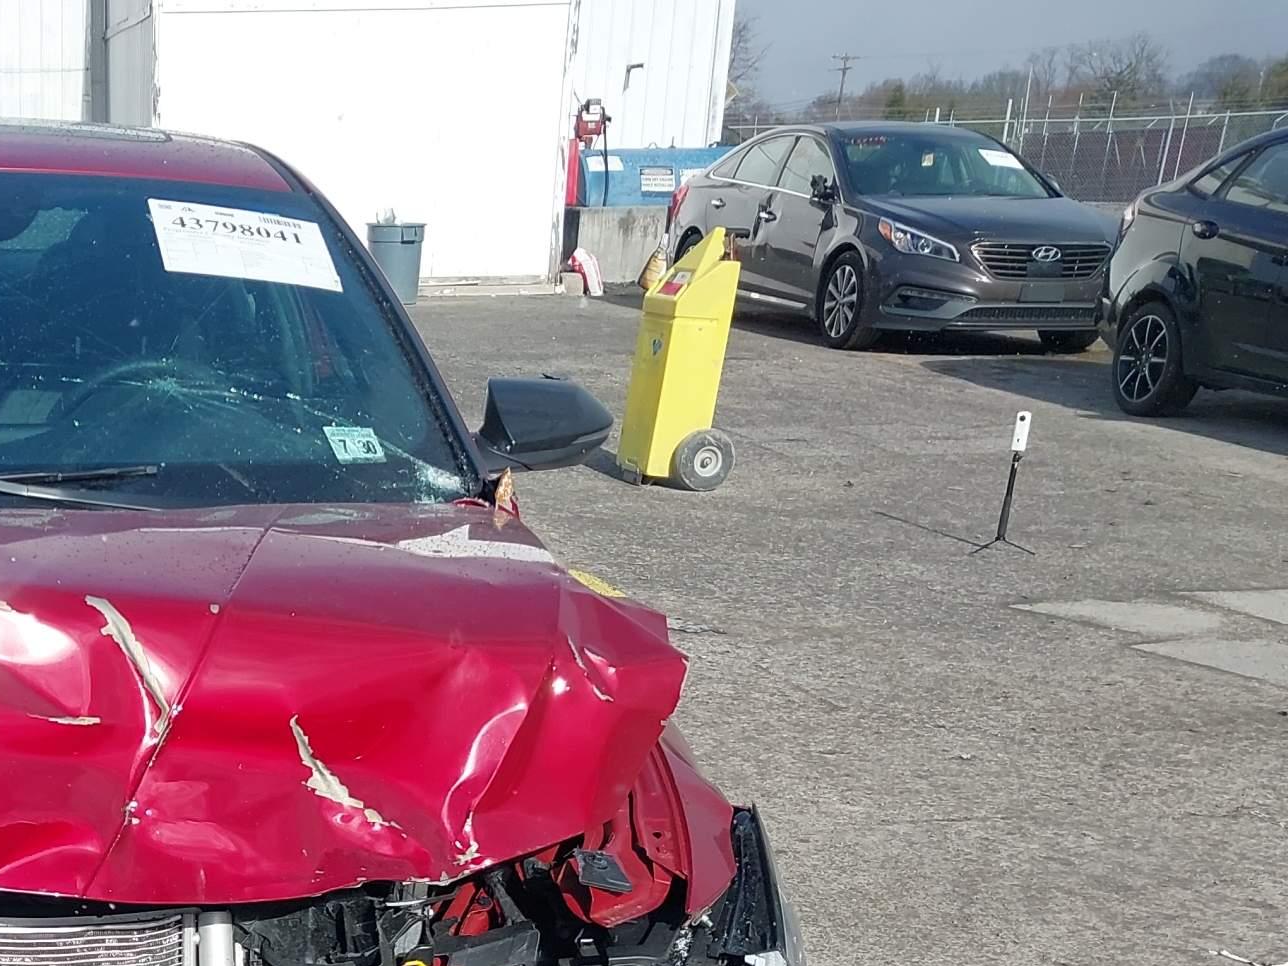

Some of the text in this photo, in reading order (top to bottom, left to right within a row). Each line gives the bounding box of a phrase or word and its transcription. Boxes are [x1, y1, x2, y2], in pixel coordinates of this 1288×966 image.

[172, 216, 303, 244] 43798041
[338, 439, 377, 455] 7 30
